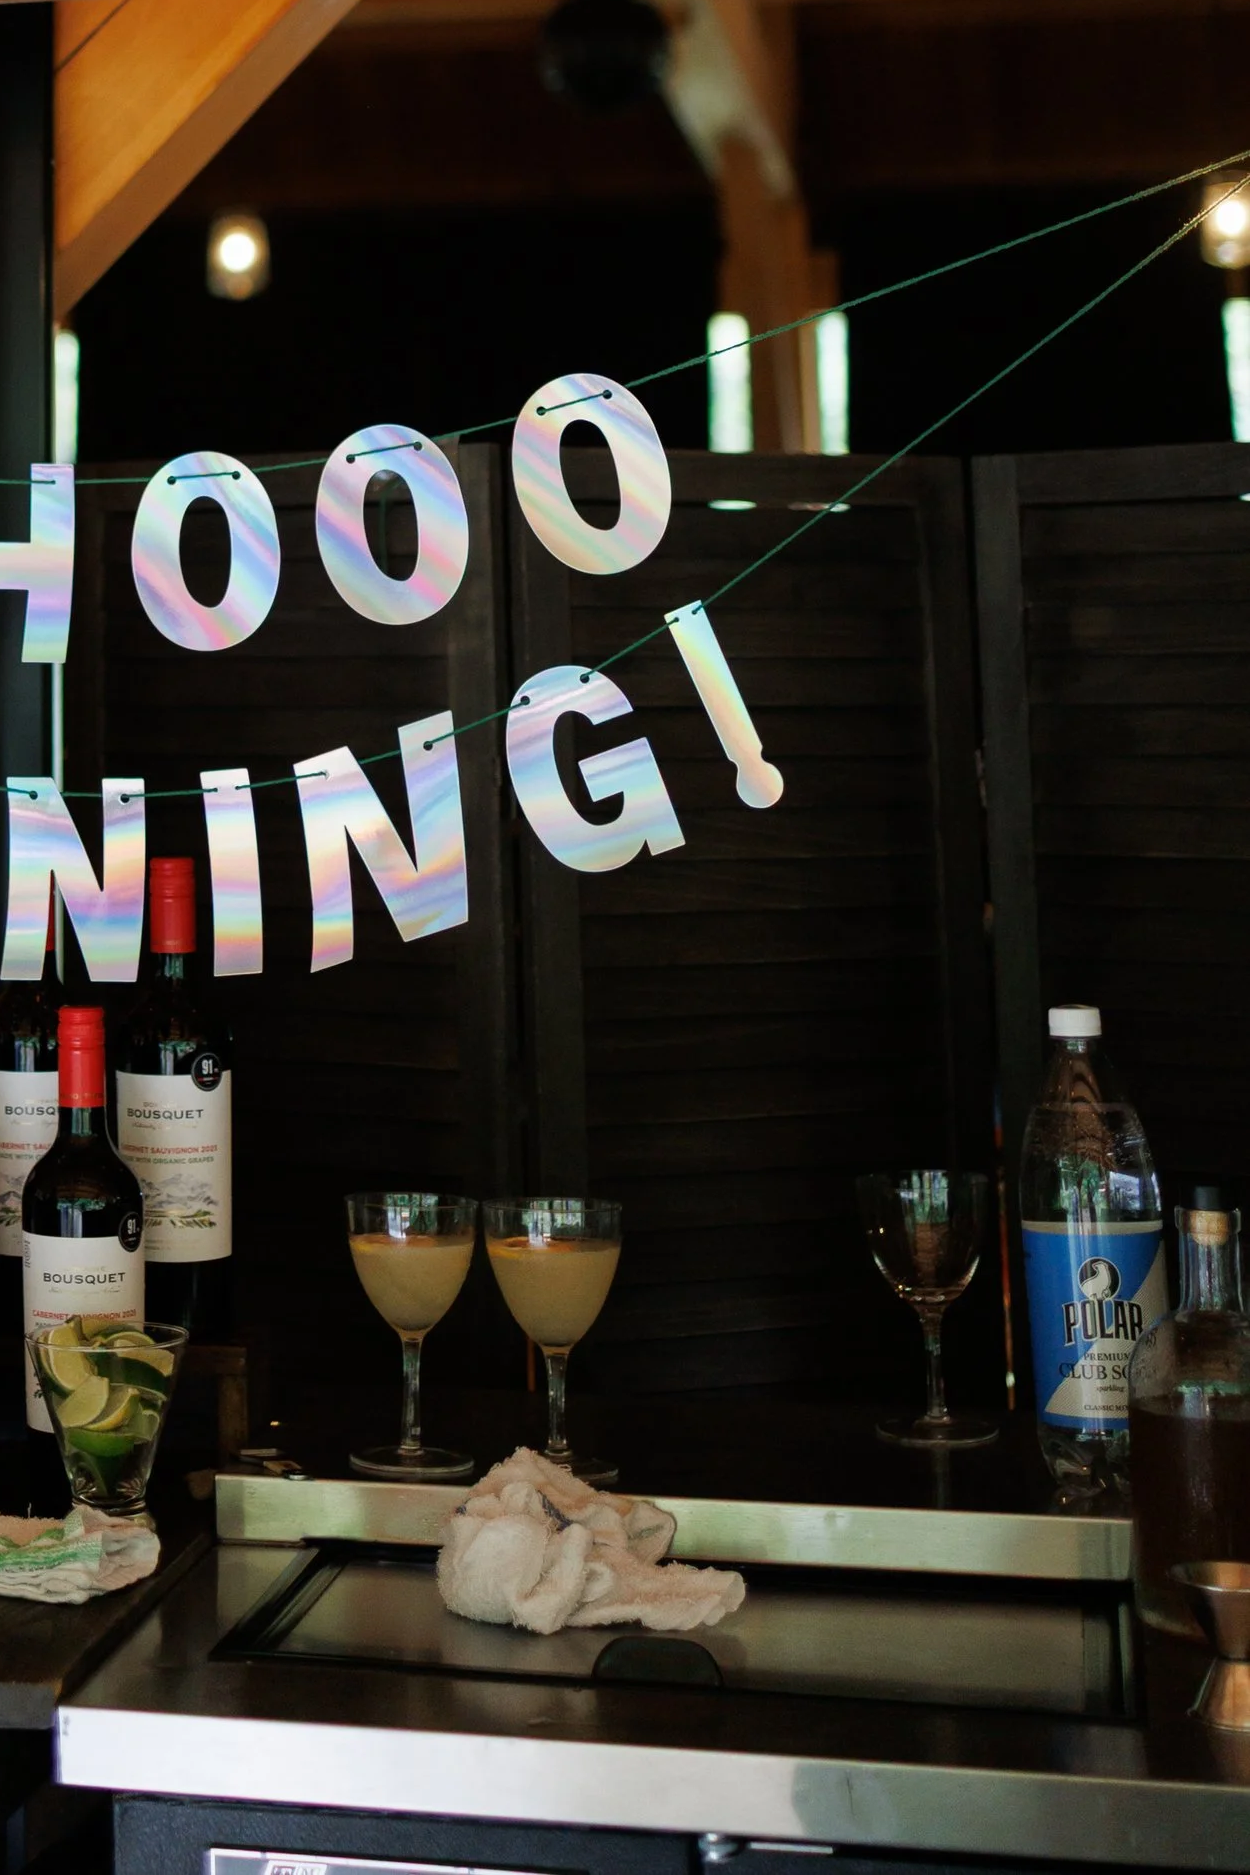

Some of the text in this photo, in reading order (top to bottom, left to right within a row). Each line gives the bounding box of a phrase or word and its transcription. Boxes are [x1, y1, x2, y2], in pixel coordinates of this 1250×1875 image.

[202, 1059, 213, 1075] 91
[5, 1105, 56, 1116] BOUSQ
[127, 1107, 204, 1120] BOUSQUET
[127, 1219, 136, 1234] 91
[43, 1272, 125, 1285] BOUSQUET
[33, 1309, 69, 1320] CABERNET
[1062, 1298, 1144, 1347] POLAR
[1058, 1362, 1108, 1380] CLUB
